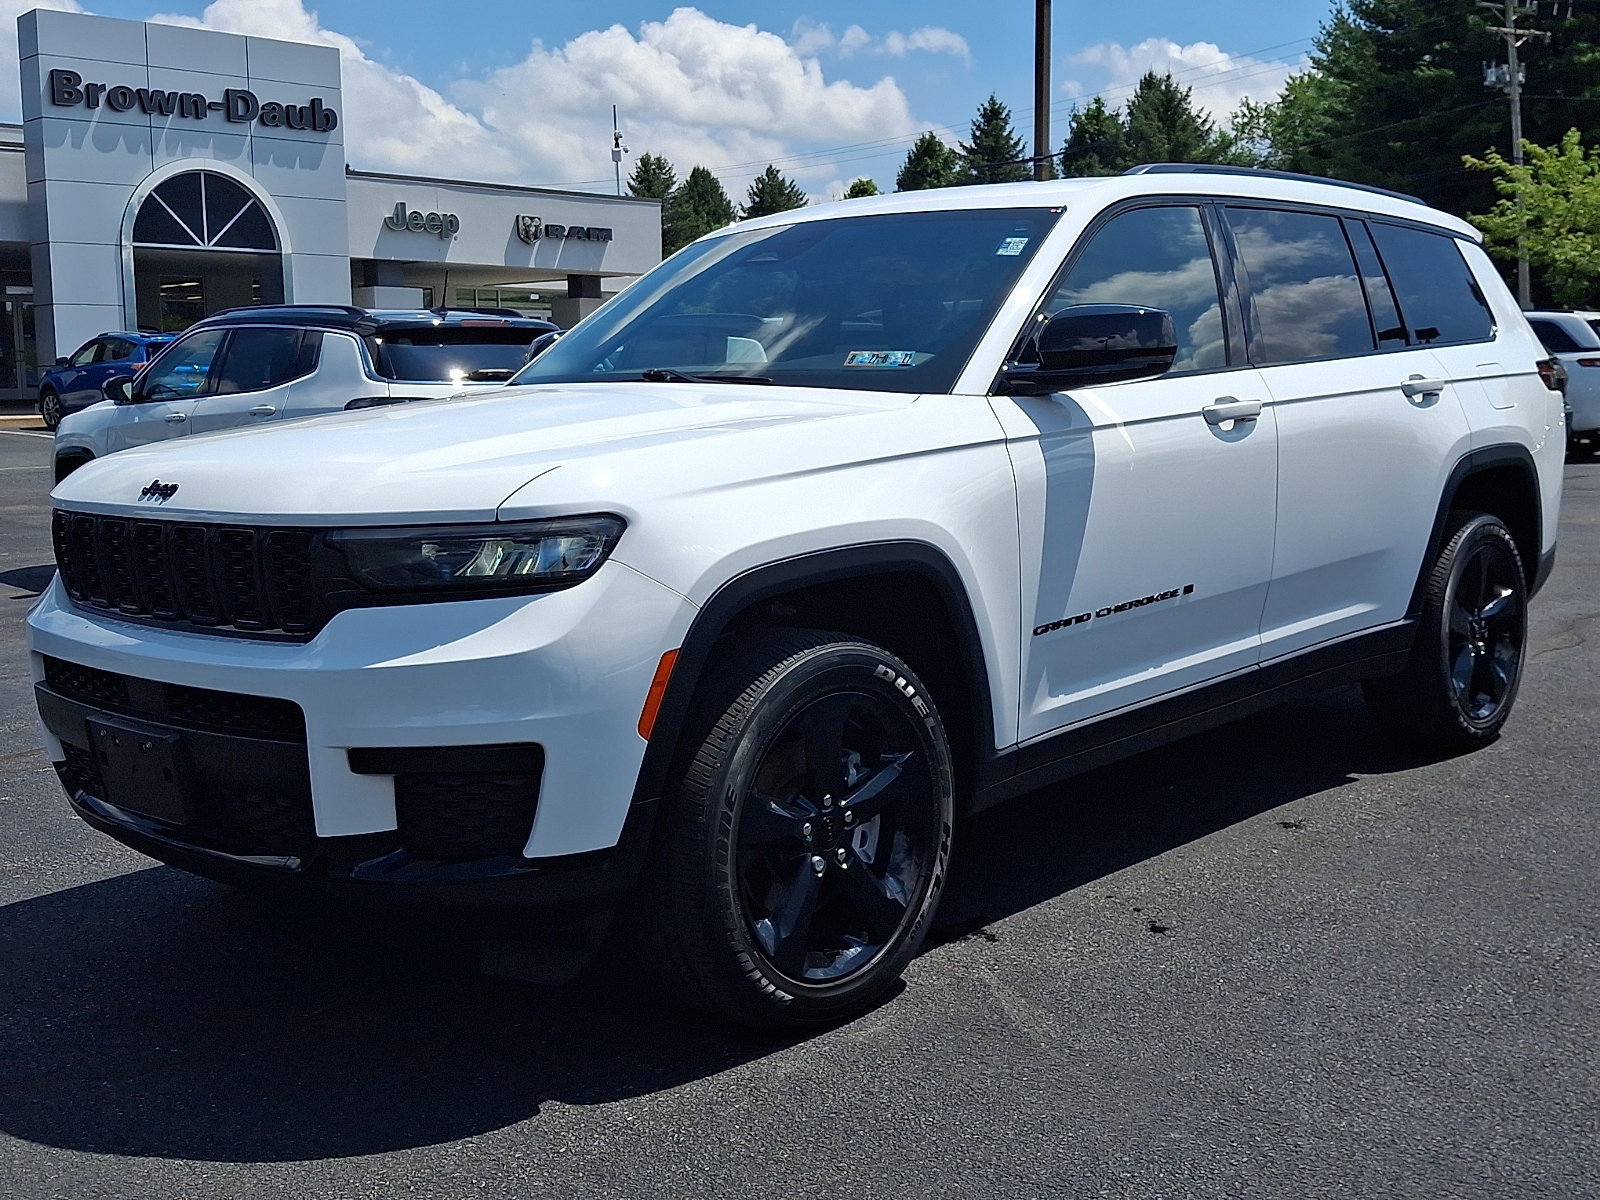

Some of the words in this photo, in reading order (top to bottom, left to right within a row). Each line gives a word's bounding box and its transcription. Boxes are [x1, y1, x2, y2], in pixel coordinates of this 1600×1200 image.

[50, 68, 338, 132] Brown-Daub
[384, 202, 460, 240] Jeep
[545, 214, 613, 241] RAM
[141, 479, 179, 502] Jeep
[1033, 612, 1092, 636] GRAND
[1095, 588, 1181, 618] CHEROKEE
